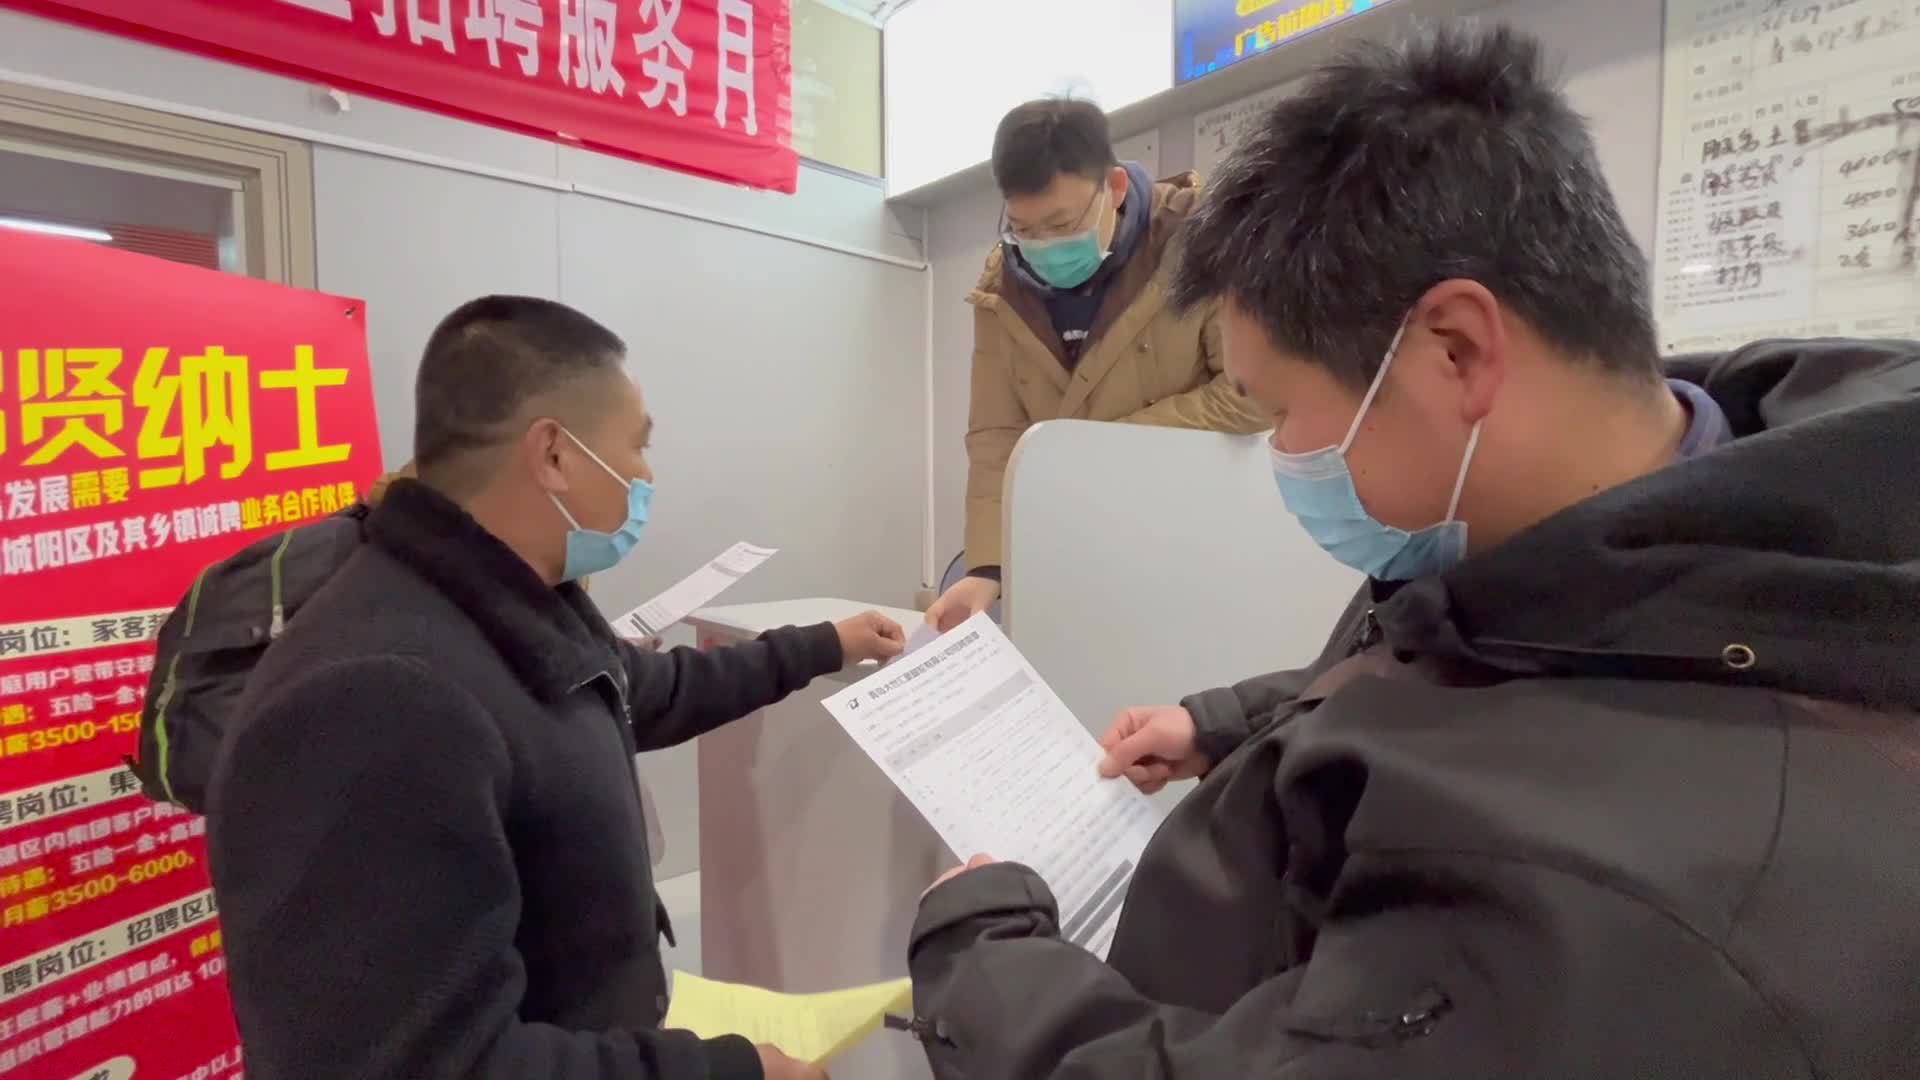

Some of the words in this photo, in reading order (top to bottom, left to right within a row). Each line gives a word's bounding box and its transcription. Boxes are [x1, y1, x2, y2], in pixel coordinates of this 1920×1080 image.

[279, 0, 758, 135] 聘服务月
[0, 344, 352, 489] 贤纳士
[0, 467, 129, 520] 发展需要
[0, 711, 143, 758] 薪3500-15
